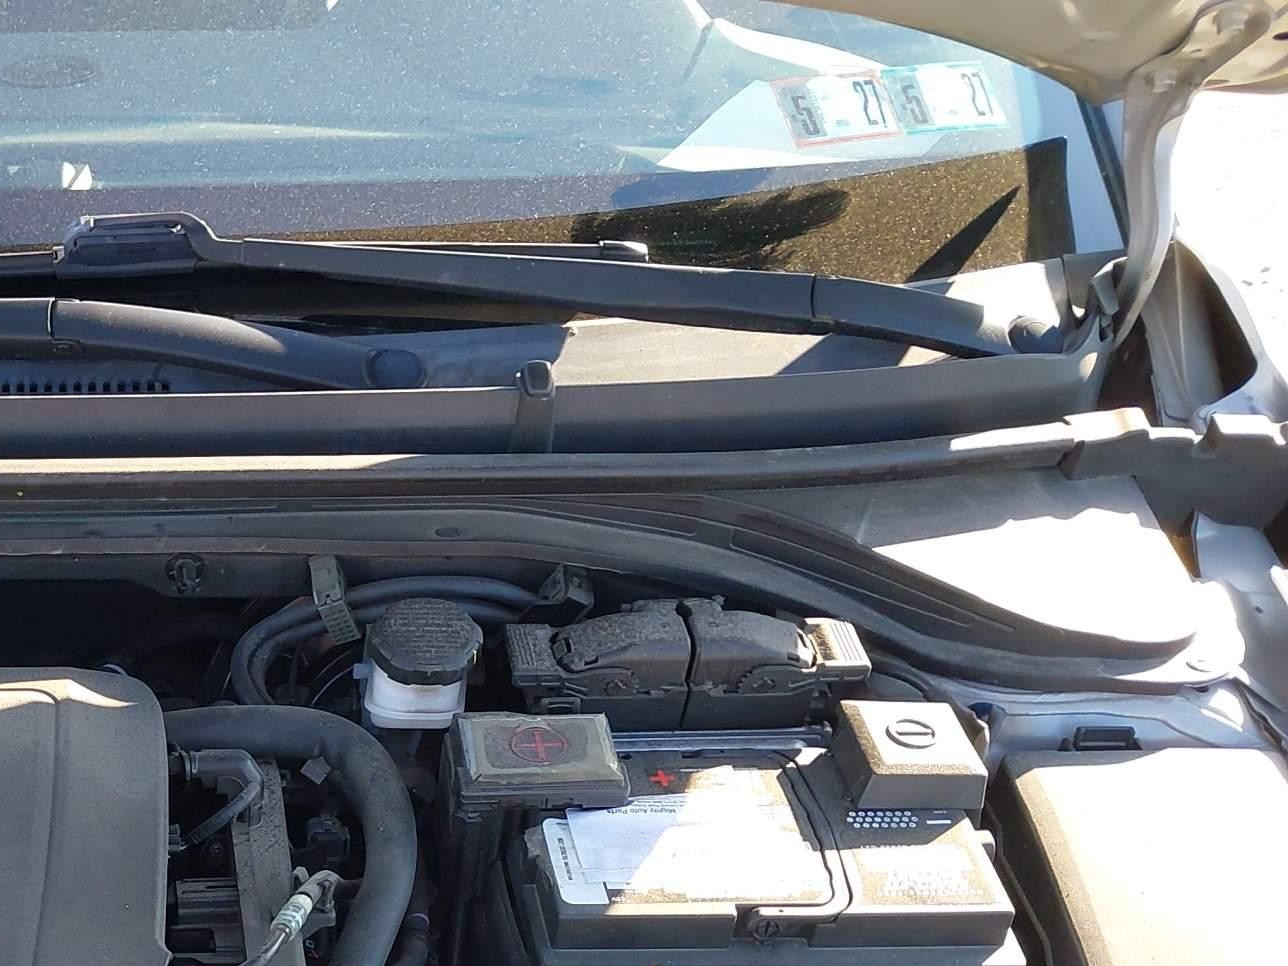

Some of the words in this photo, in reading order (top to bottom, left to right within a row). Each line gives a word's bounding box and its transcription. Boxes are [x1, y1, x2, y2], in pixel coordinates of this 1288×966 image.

[791, 94, 821, 137] 5
[851, 79, 888, 128] 27
[900, 83, 929, 125] 5
[960, 71, 995, 117] 27
